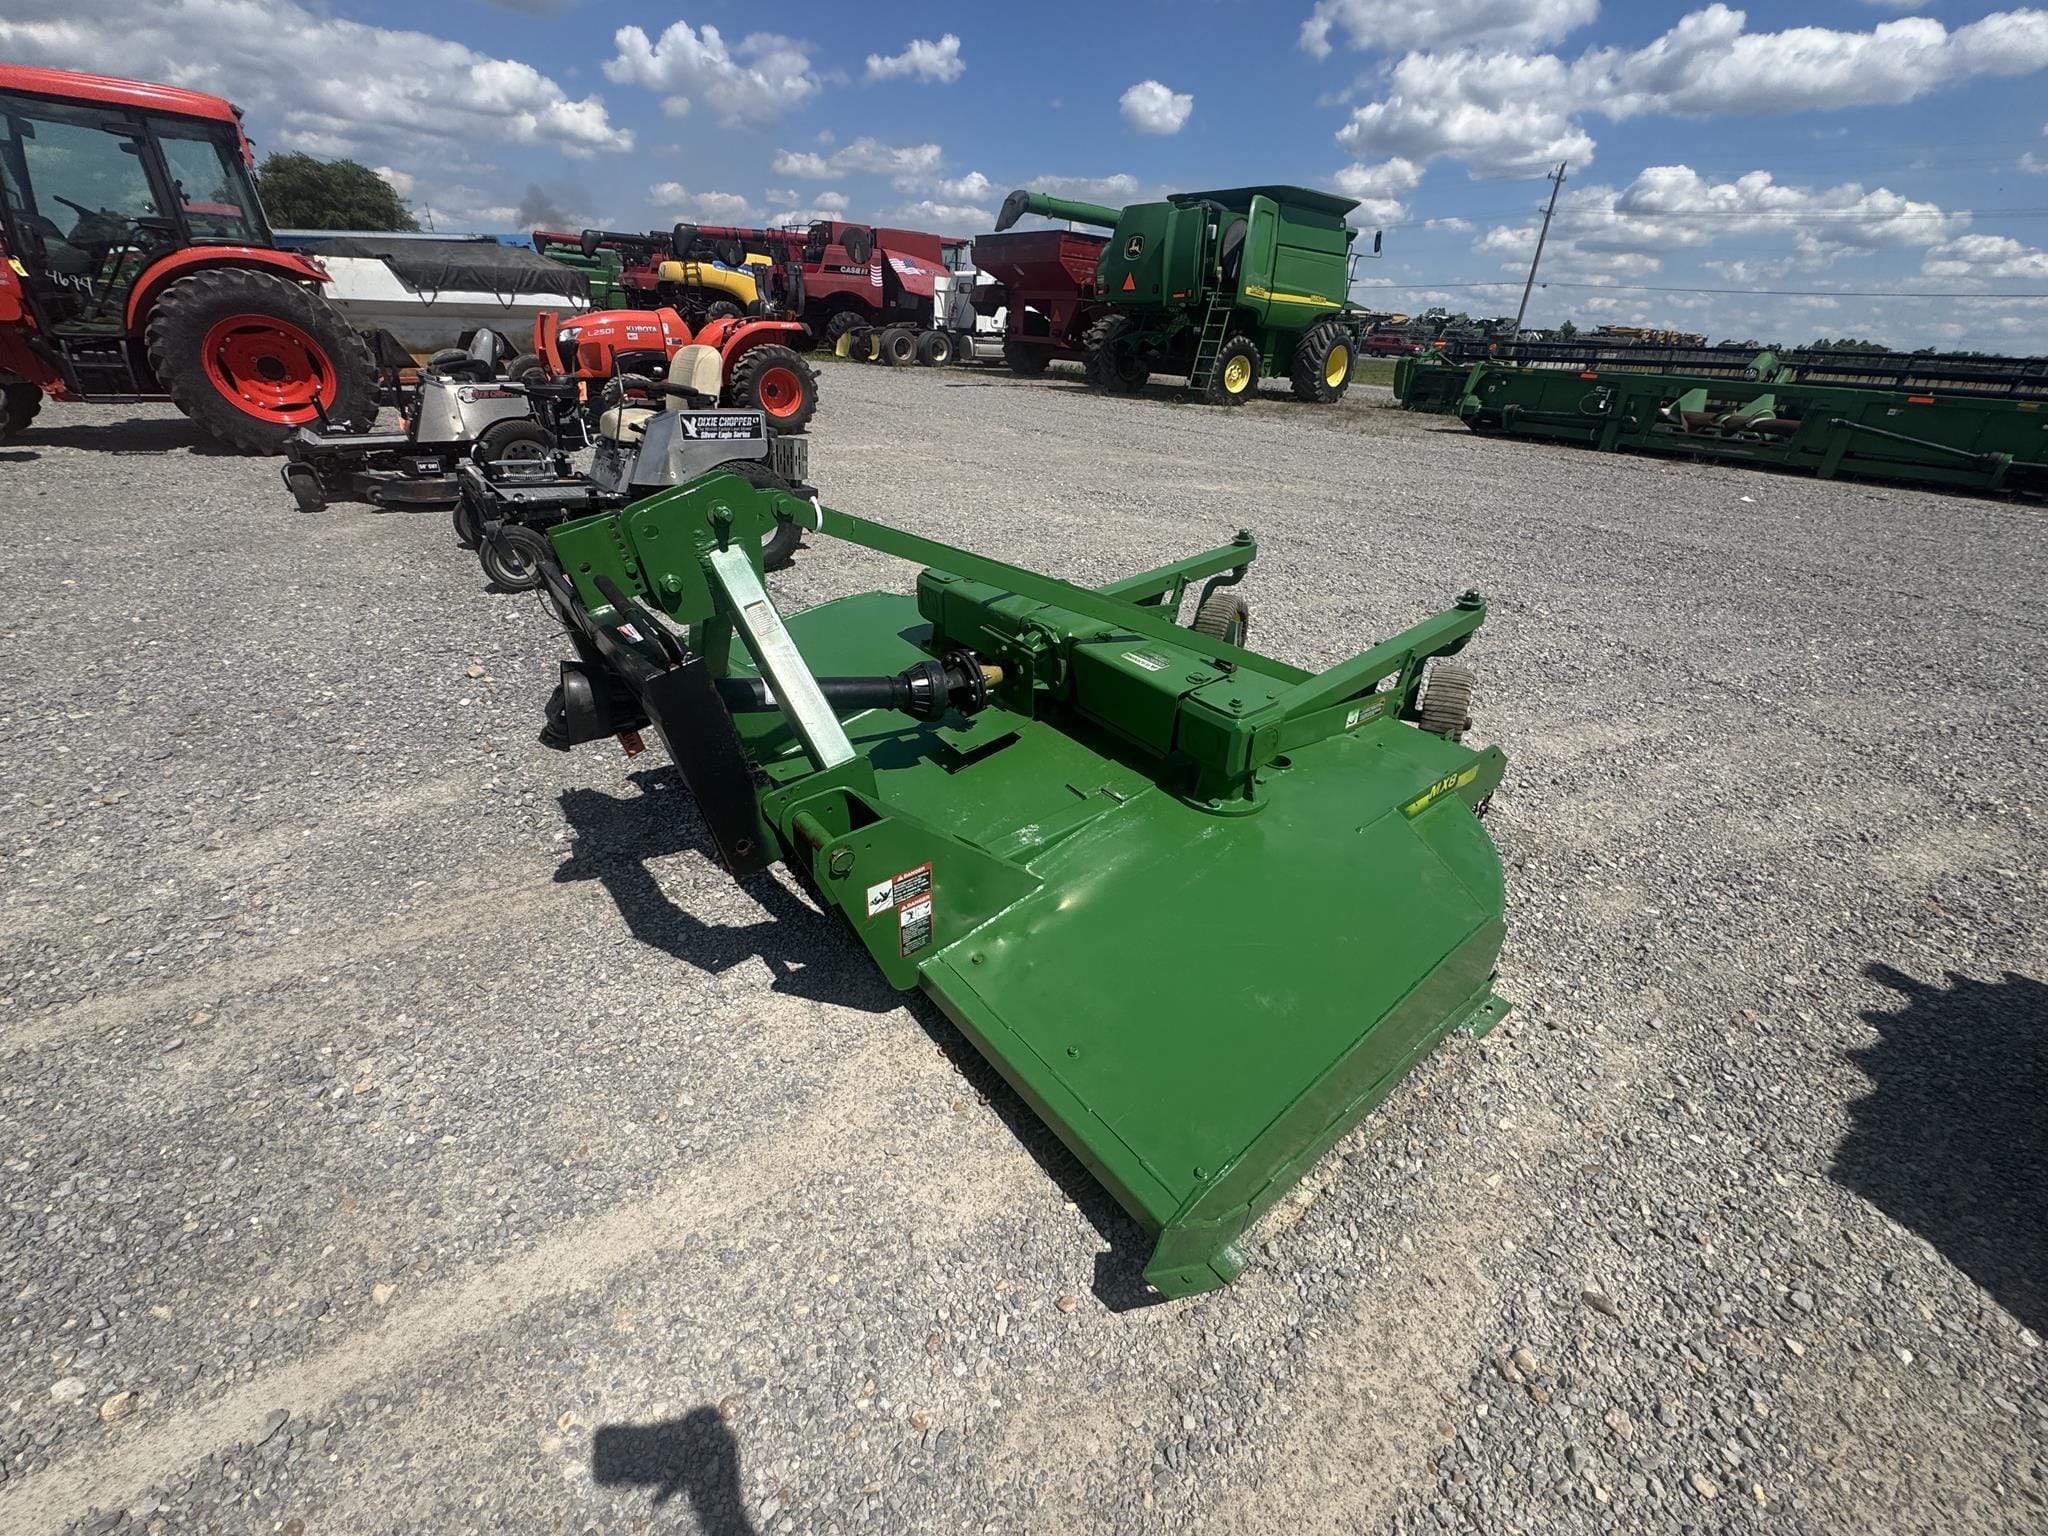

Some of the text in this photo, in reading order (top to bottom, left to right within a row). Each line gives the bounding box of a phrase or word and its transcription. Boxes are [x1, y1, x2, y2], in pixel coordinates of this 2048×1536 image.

[840, 266, 860, 275] CASE
[626, 325, 657, 333] KUBOTA
[697, 416, 718, 427] DIXIE
[719, 416, 752, 427] CHOPPER
[718, 431, 733, 440] Eagle
[1429, 772, 1458, 798] MX8
